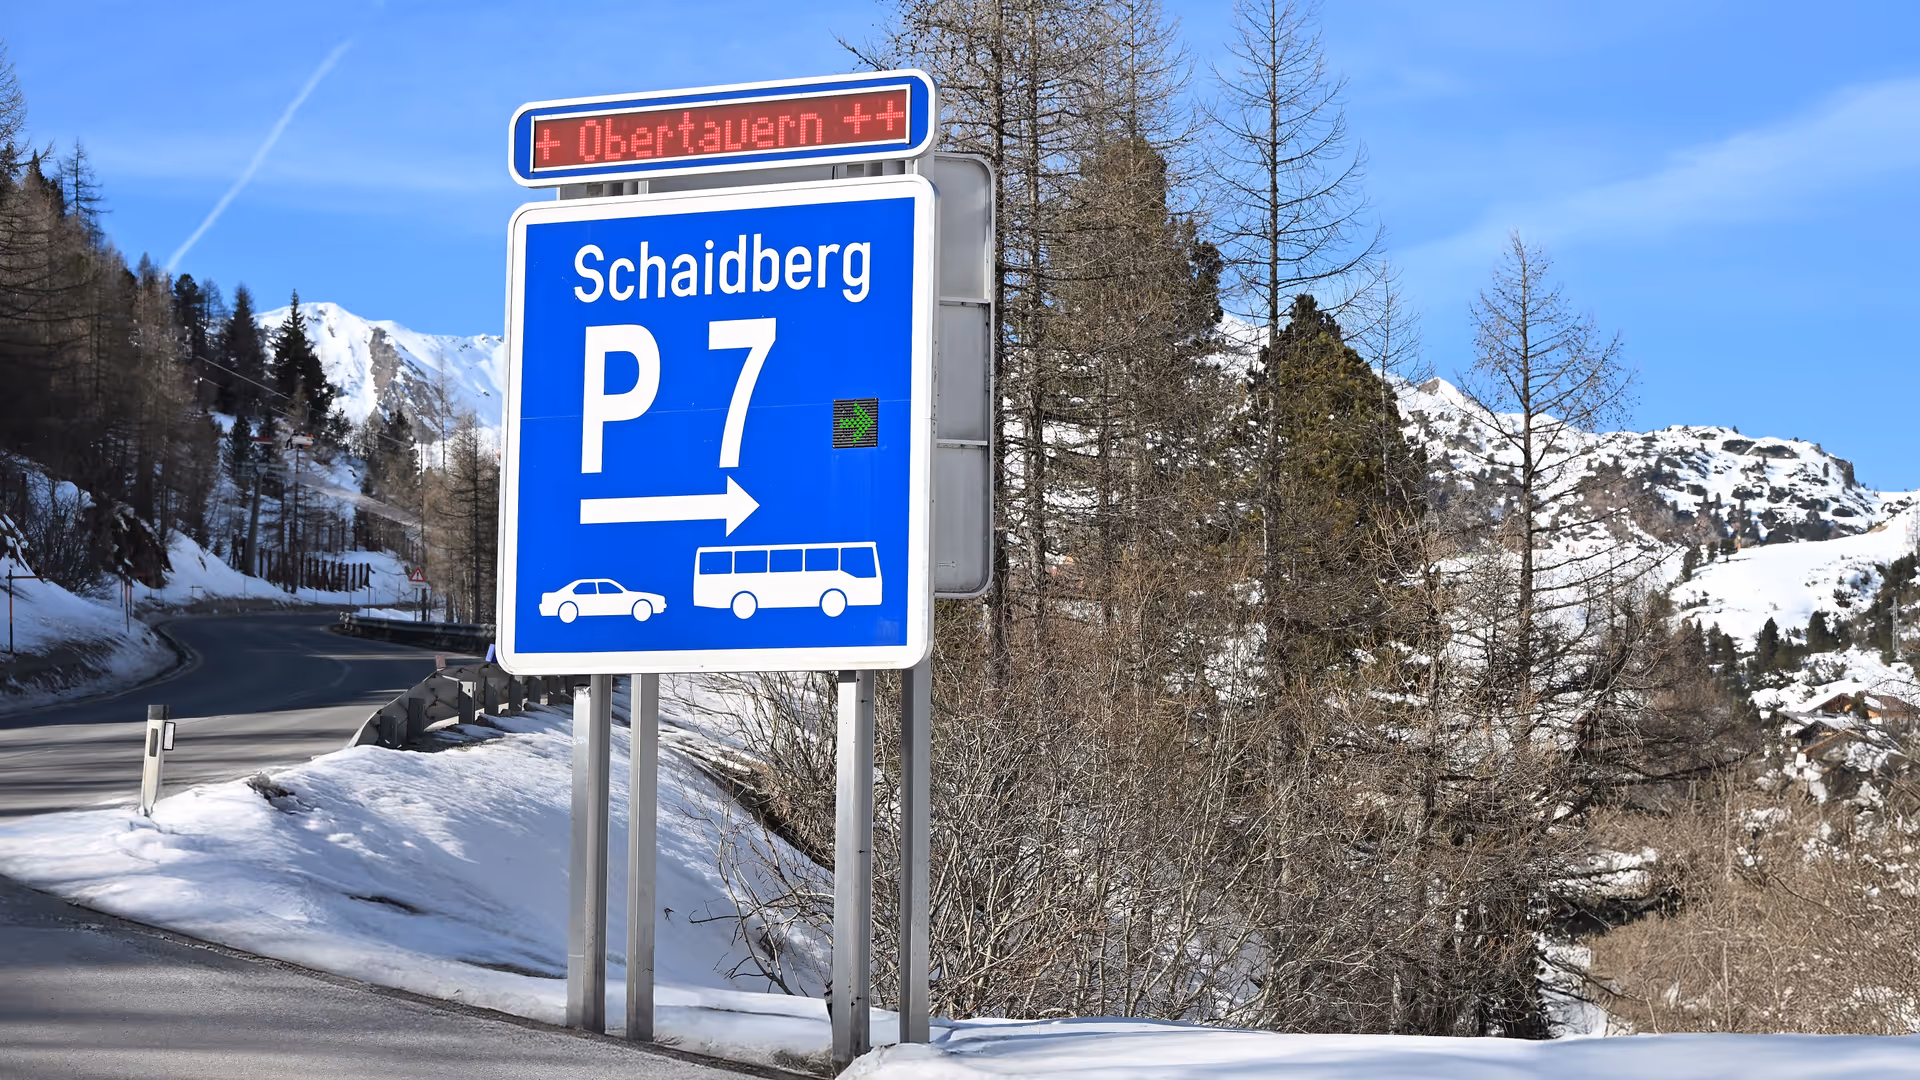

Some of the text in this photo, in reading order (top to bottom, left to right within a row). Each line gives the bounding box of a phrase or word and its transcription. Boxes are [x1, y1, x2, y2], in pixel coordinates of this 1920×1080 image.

[579, 111, 823, 162] Obertauern
[574, 233, 871, 303] Schaidberg
[581, 317, 777, 474] P 7
